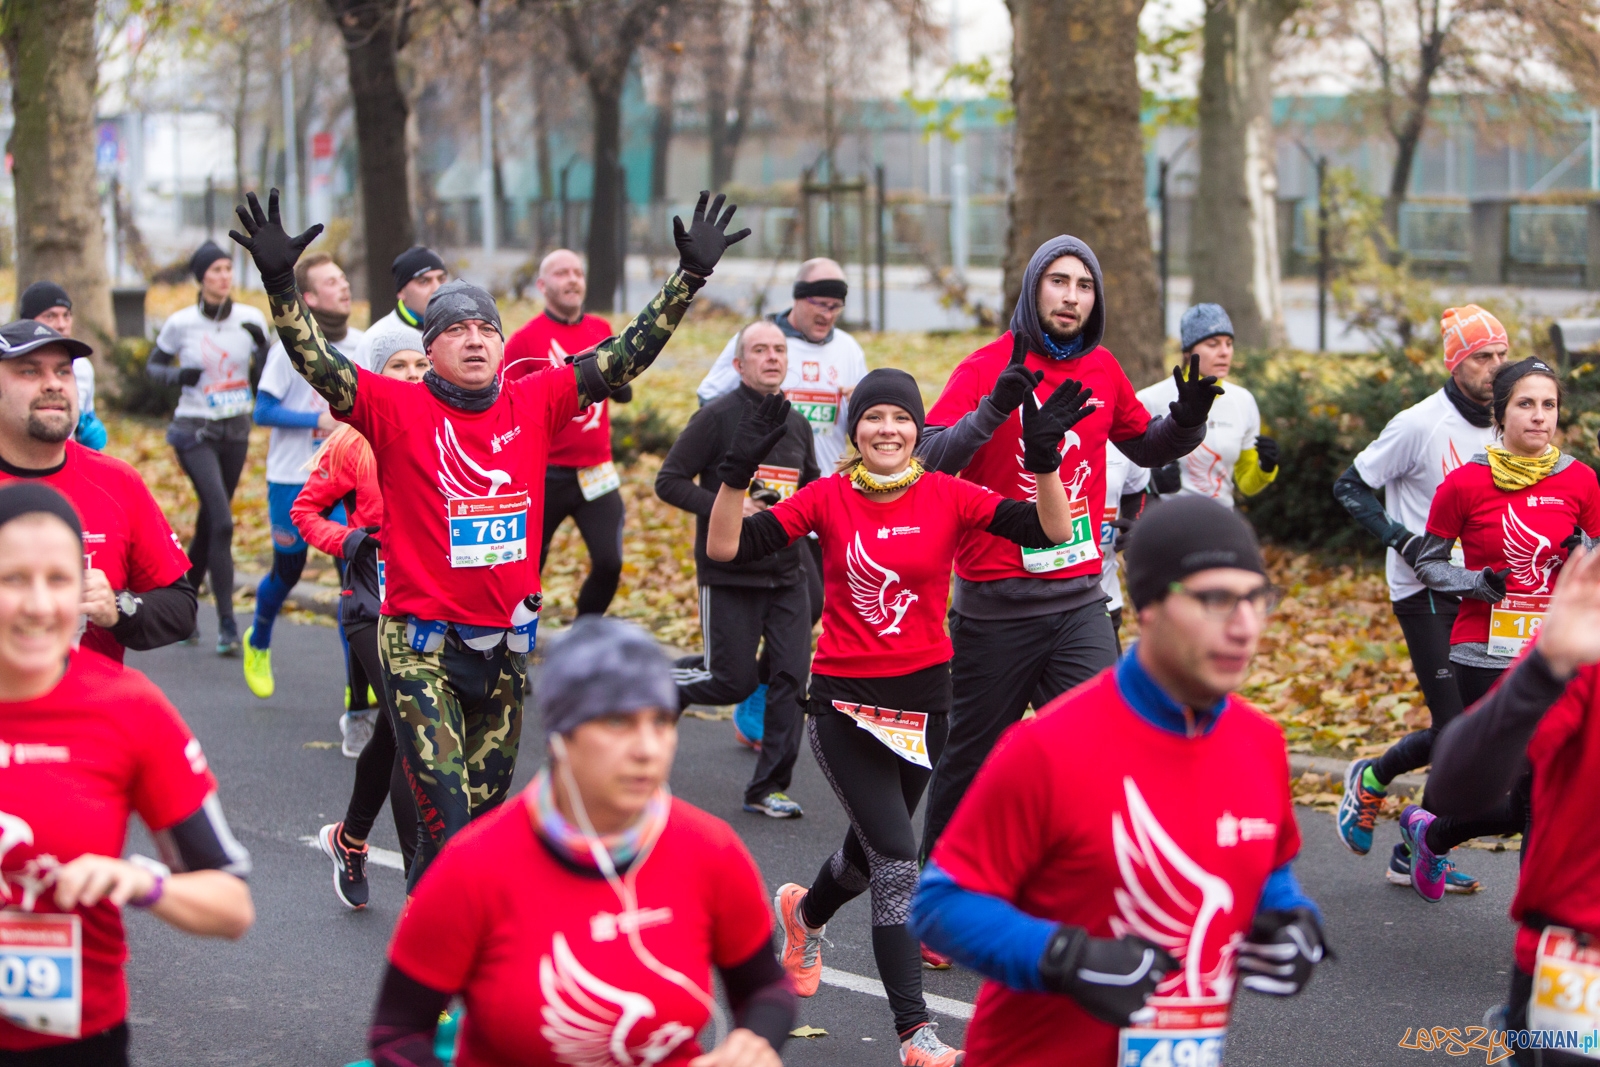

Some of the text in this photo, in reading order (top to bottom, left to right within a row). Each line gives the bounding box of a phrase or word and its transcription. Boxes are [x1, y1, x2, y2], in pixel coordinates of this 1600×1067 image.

[453, 517, 518, 543] E 761
[1494, 620, 1500, 628] D
[0, 955, 60, 998] 09
